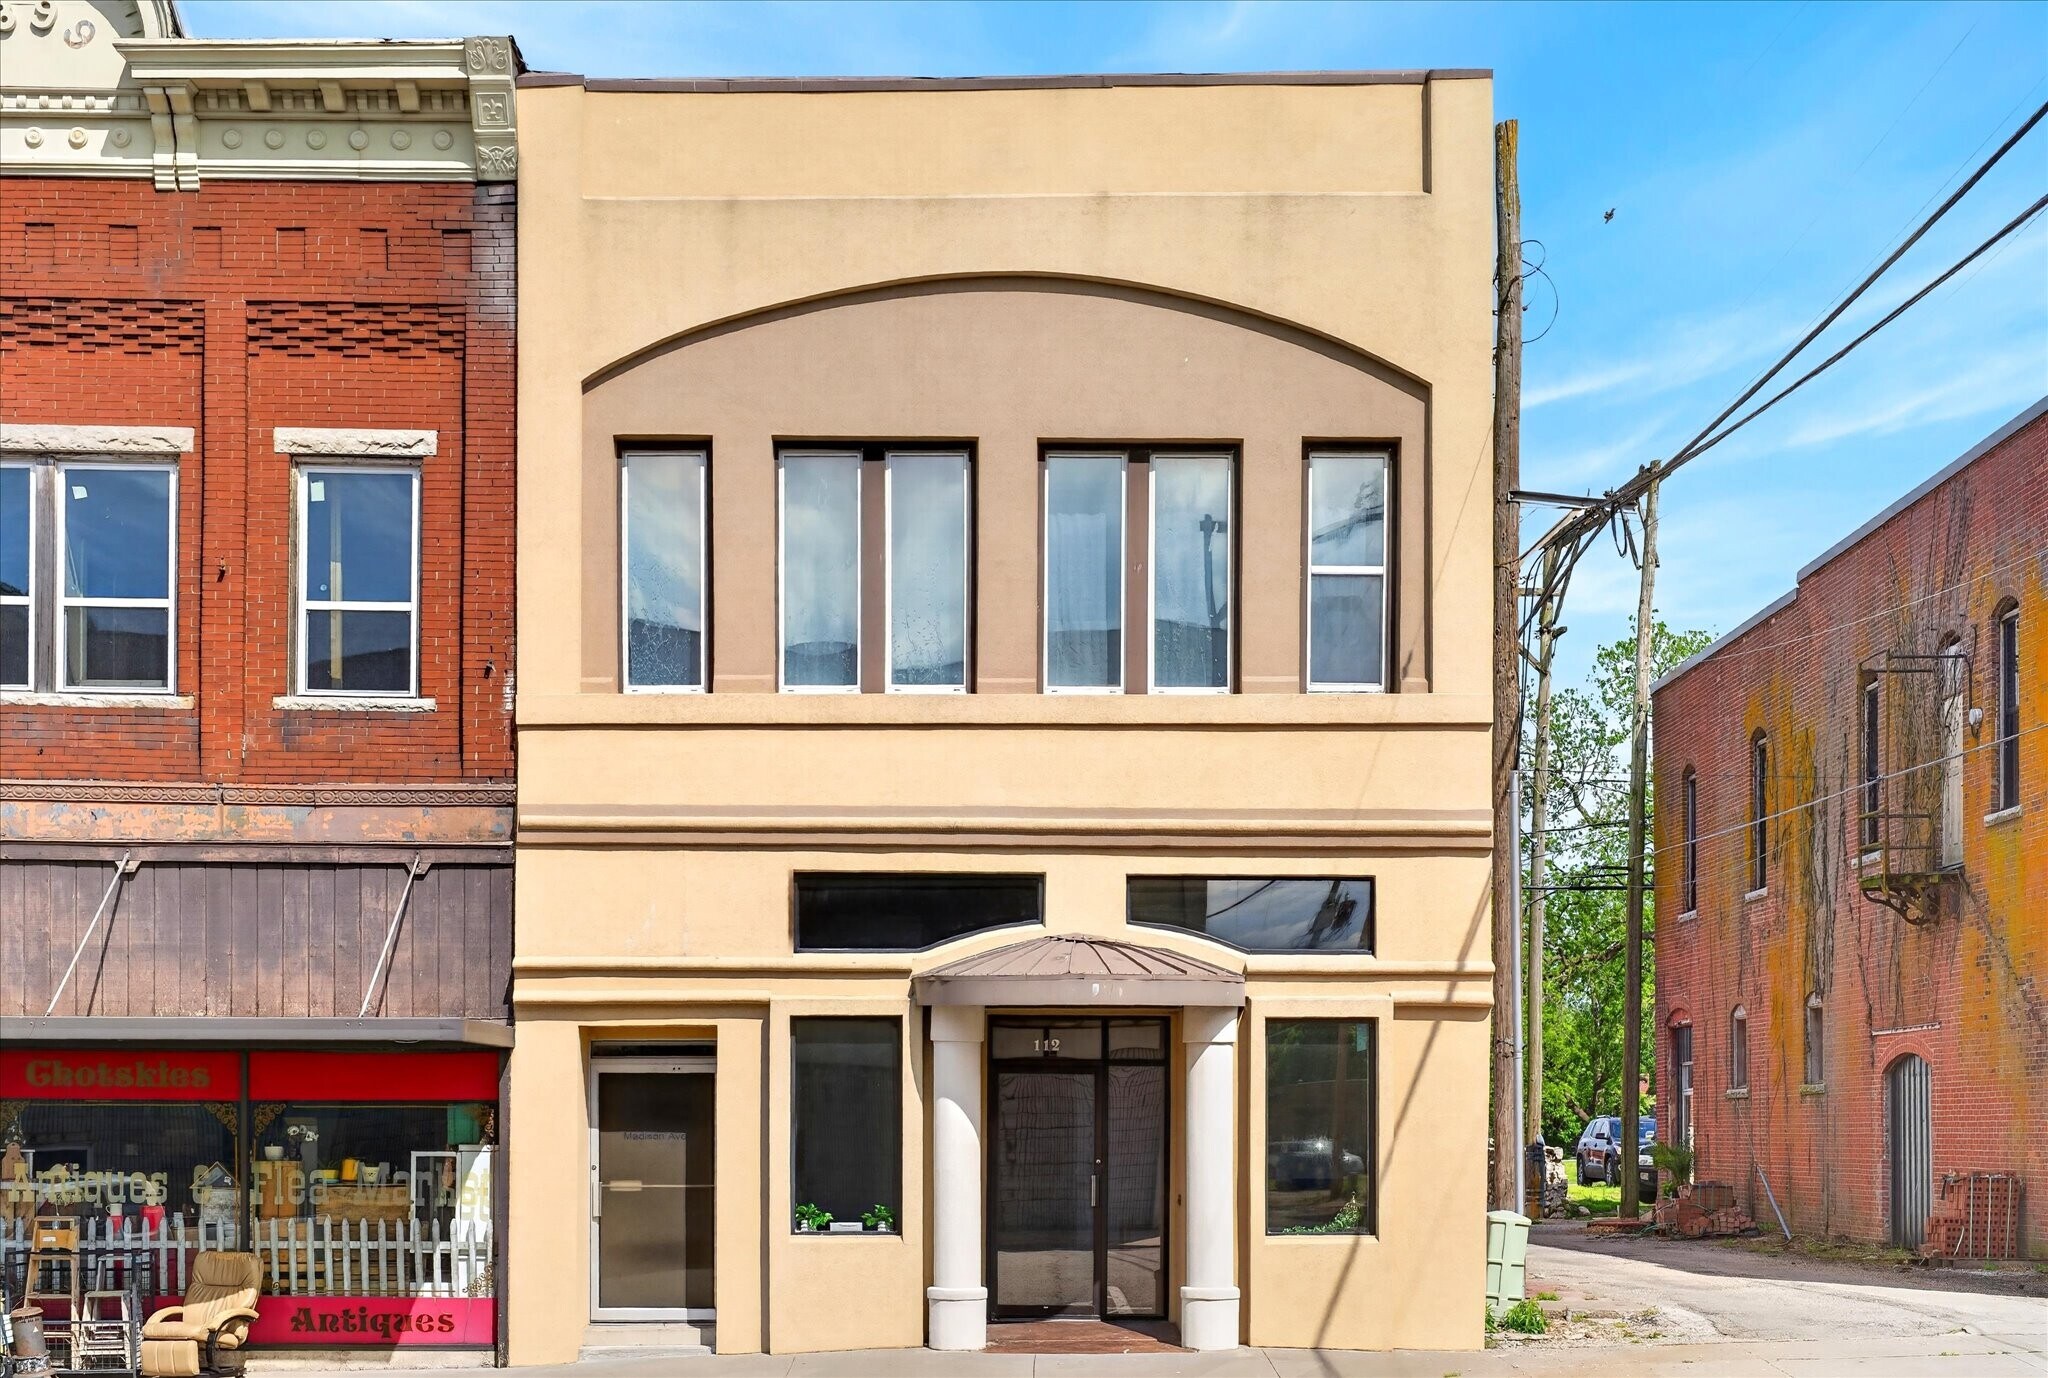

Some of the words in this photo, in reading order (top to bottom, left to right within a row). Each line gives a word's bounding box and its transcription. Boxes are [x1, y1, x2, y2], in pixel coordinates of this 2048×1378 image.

[1034, 1039, 1061, 1052] 112
[623, 1131, 665, 1141] Madison
[8, 1162, 168, 1208] Antiques
[250, 1161, 331, 1206] Flea
[290, 1306, 456, 1339] Antiques
